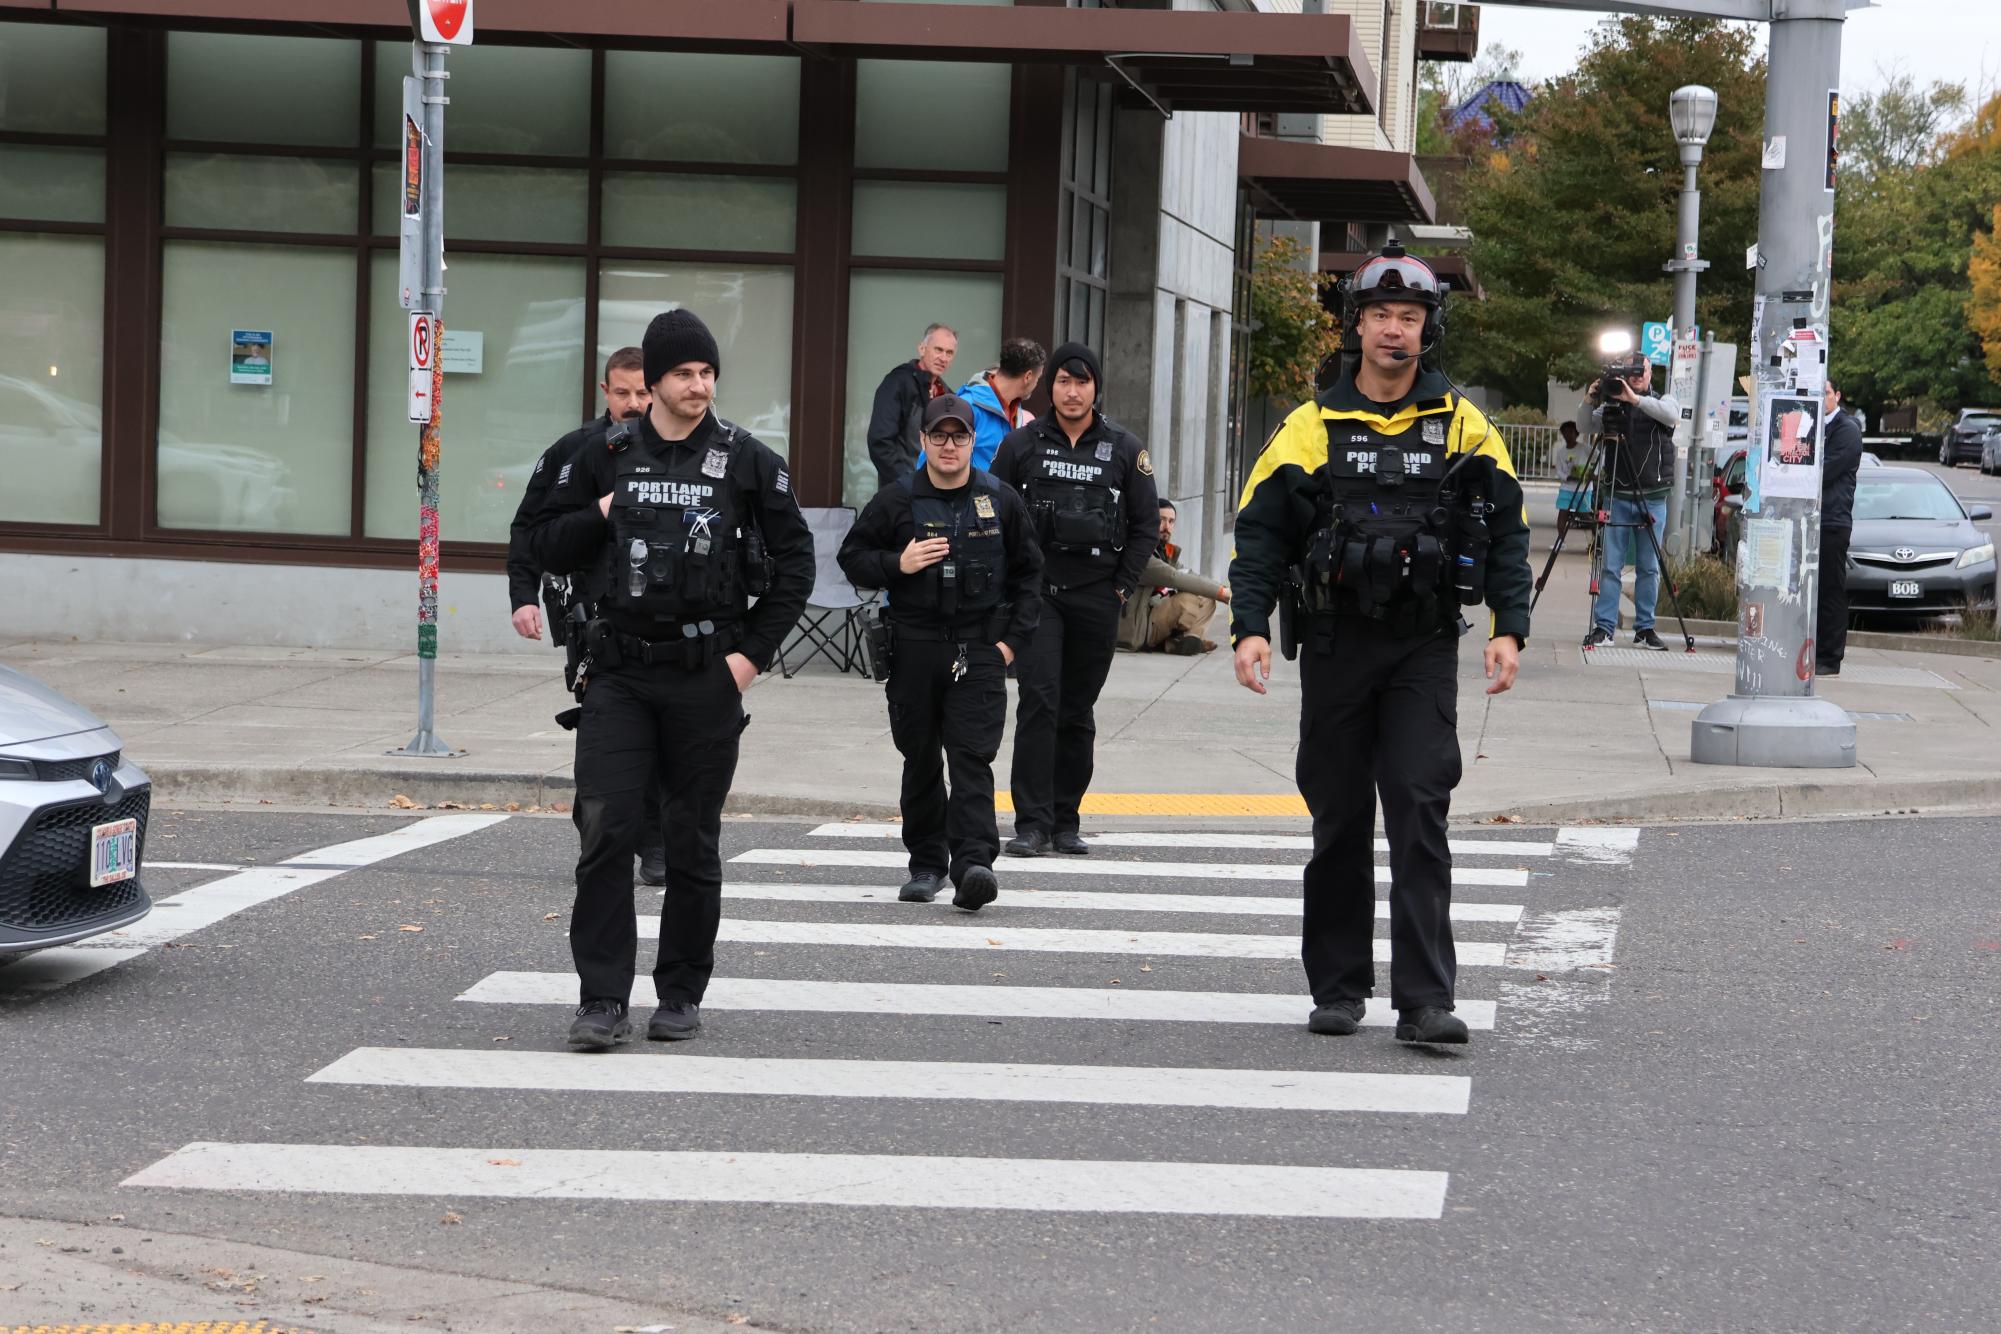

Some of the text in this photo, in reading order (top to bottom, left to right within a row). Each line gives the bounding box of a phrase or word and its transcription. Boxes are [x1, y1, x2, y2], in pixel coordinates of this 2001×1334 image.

[1783, 455, 1803, 463] CITY
[1042, 460, 1103, 475] PORTLAND
[1357, 462, 1421, 474] POCE
[1048, 468, 1094, 482] POLICE
[627, 481, 714, 497] PORTLAND
[637, 492, 702, 507] POLICE
[1892, 582, 1920, 596] BOB
